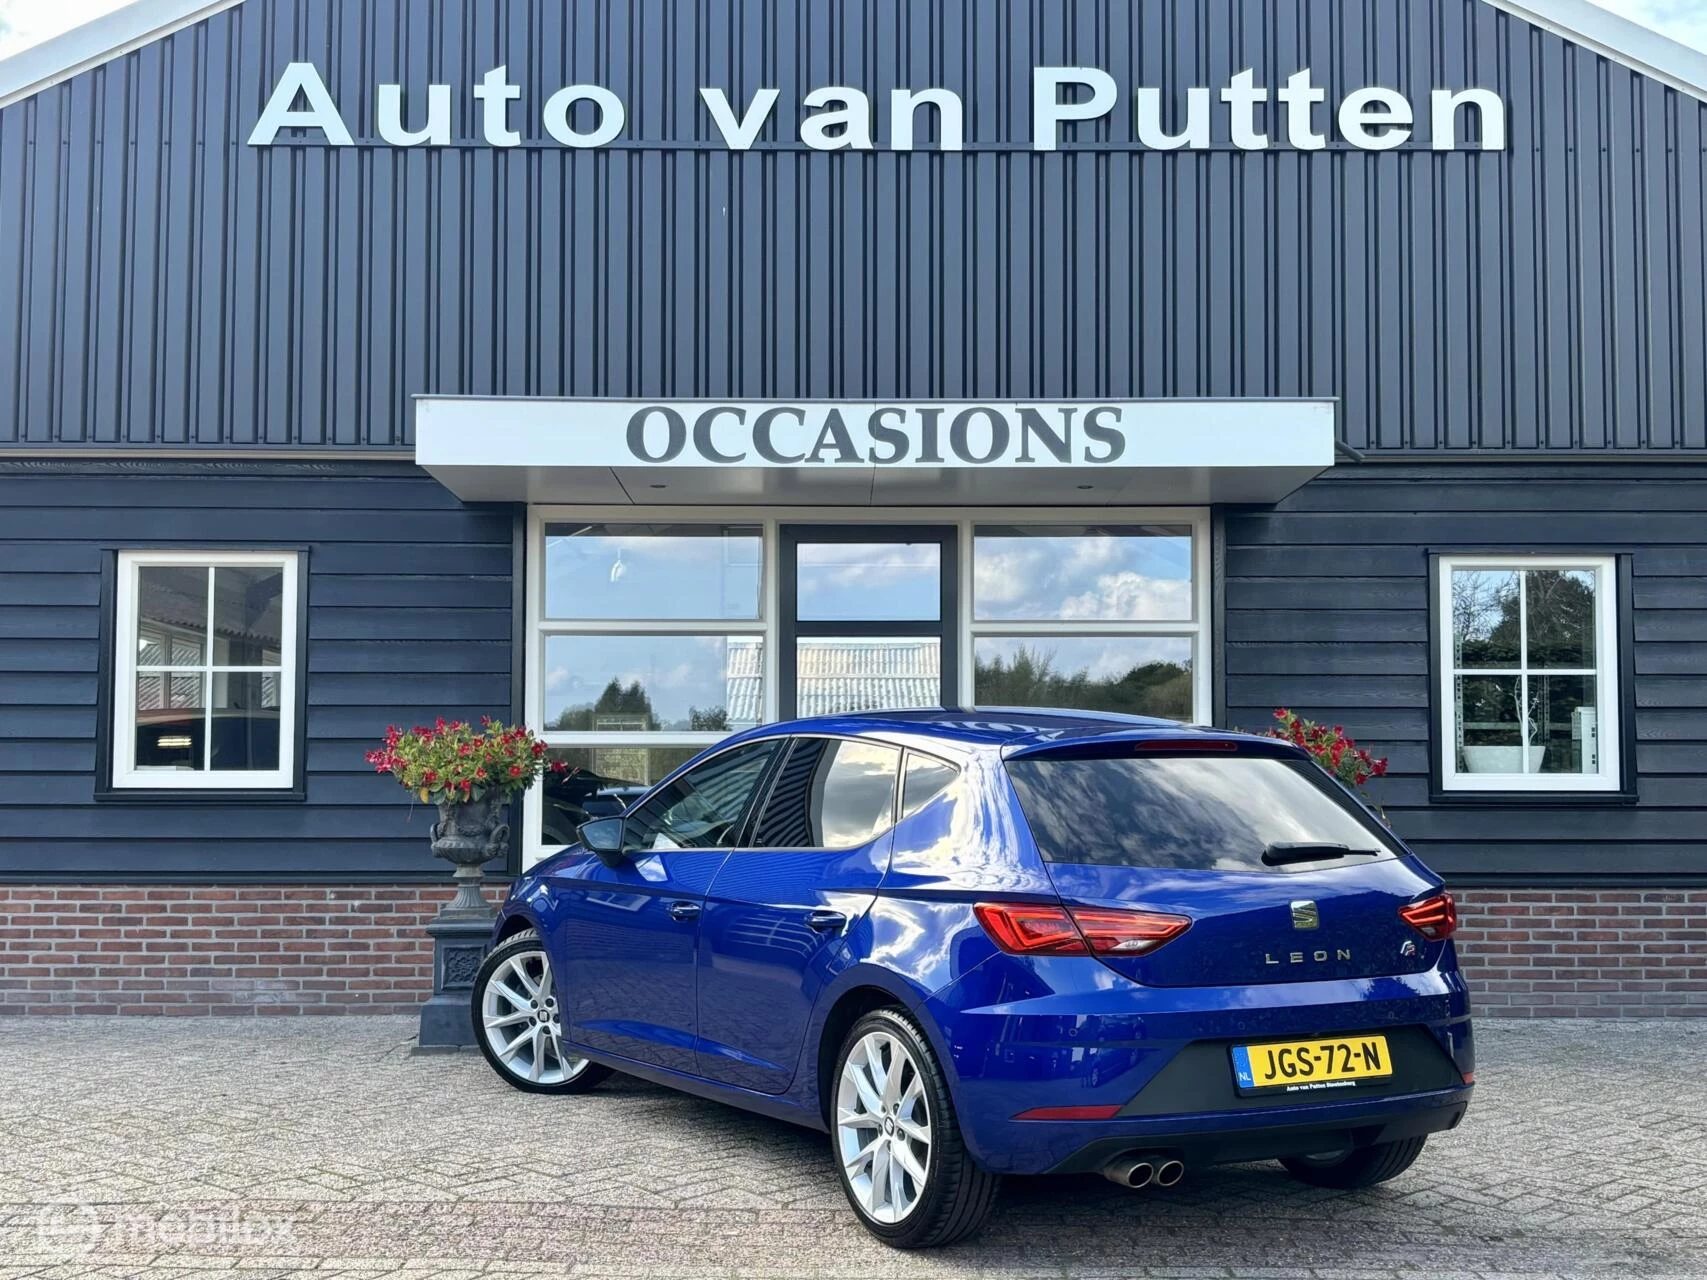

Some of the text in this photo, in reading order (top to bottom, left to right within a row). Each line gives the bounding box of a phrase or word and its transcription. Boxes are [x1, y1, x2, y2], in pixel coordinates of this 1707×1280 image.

[247, 62, 1506, 151] Auto van Putten
[626, 405, 1127, 465] OCCASIONS
[1265, 949, 1351, 964] LEON
[1239, 1071, 1251, 1081] NL
[1264, 1041, 1382, 1080] JGS-72-N
